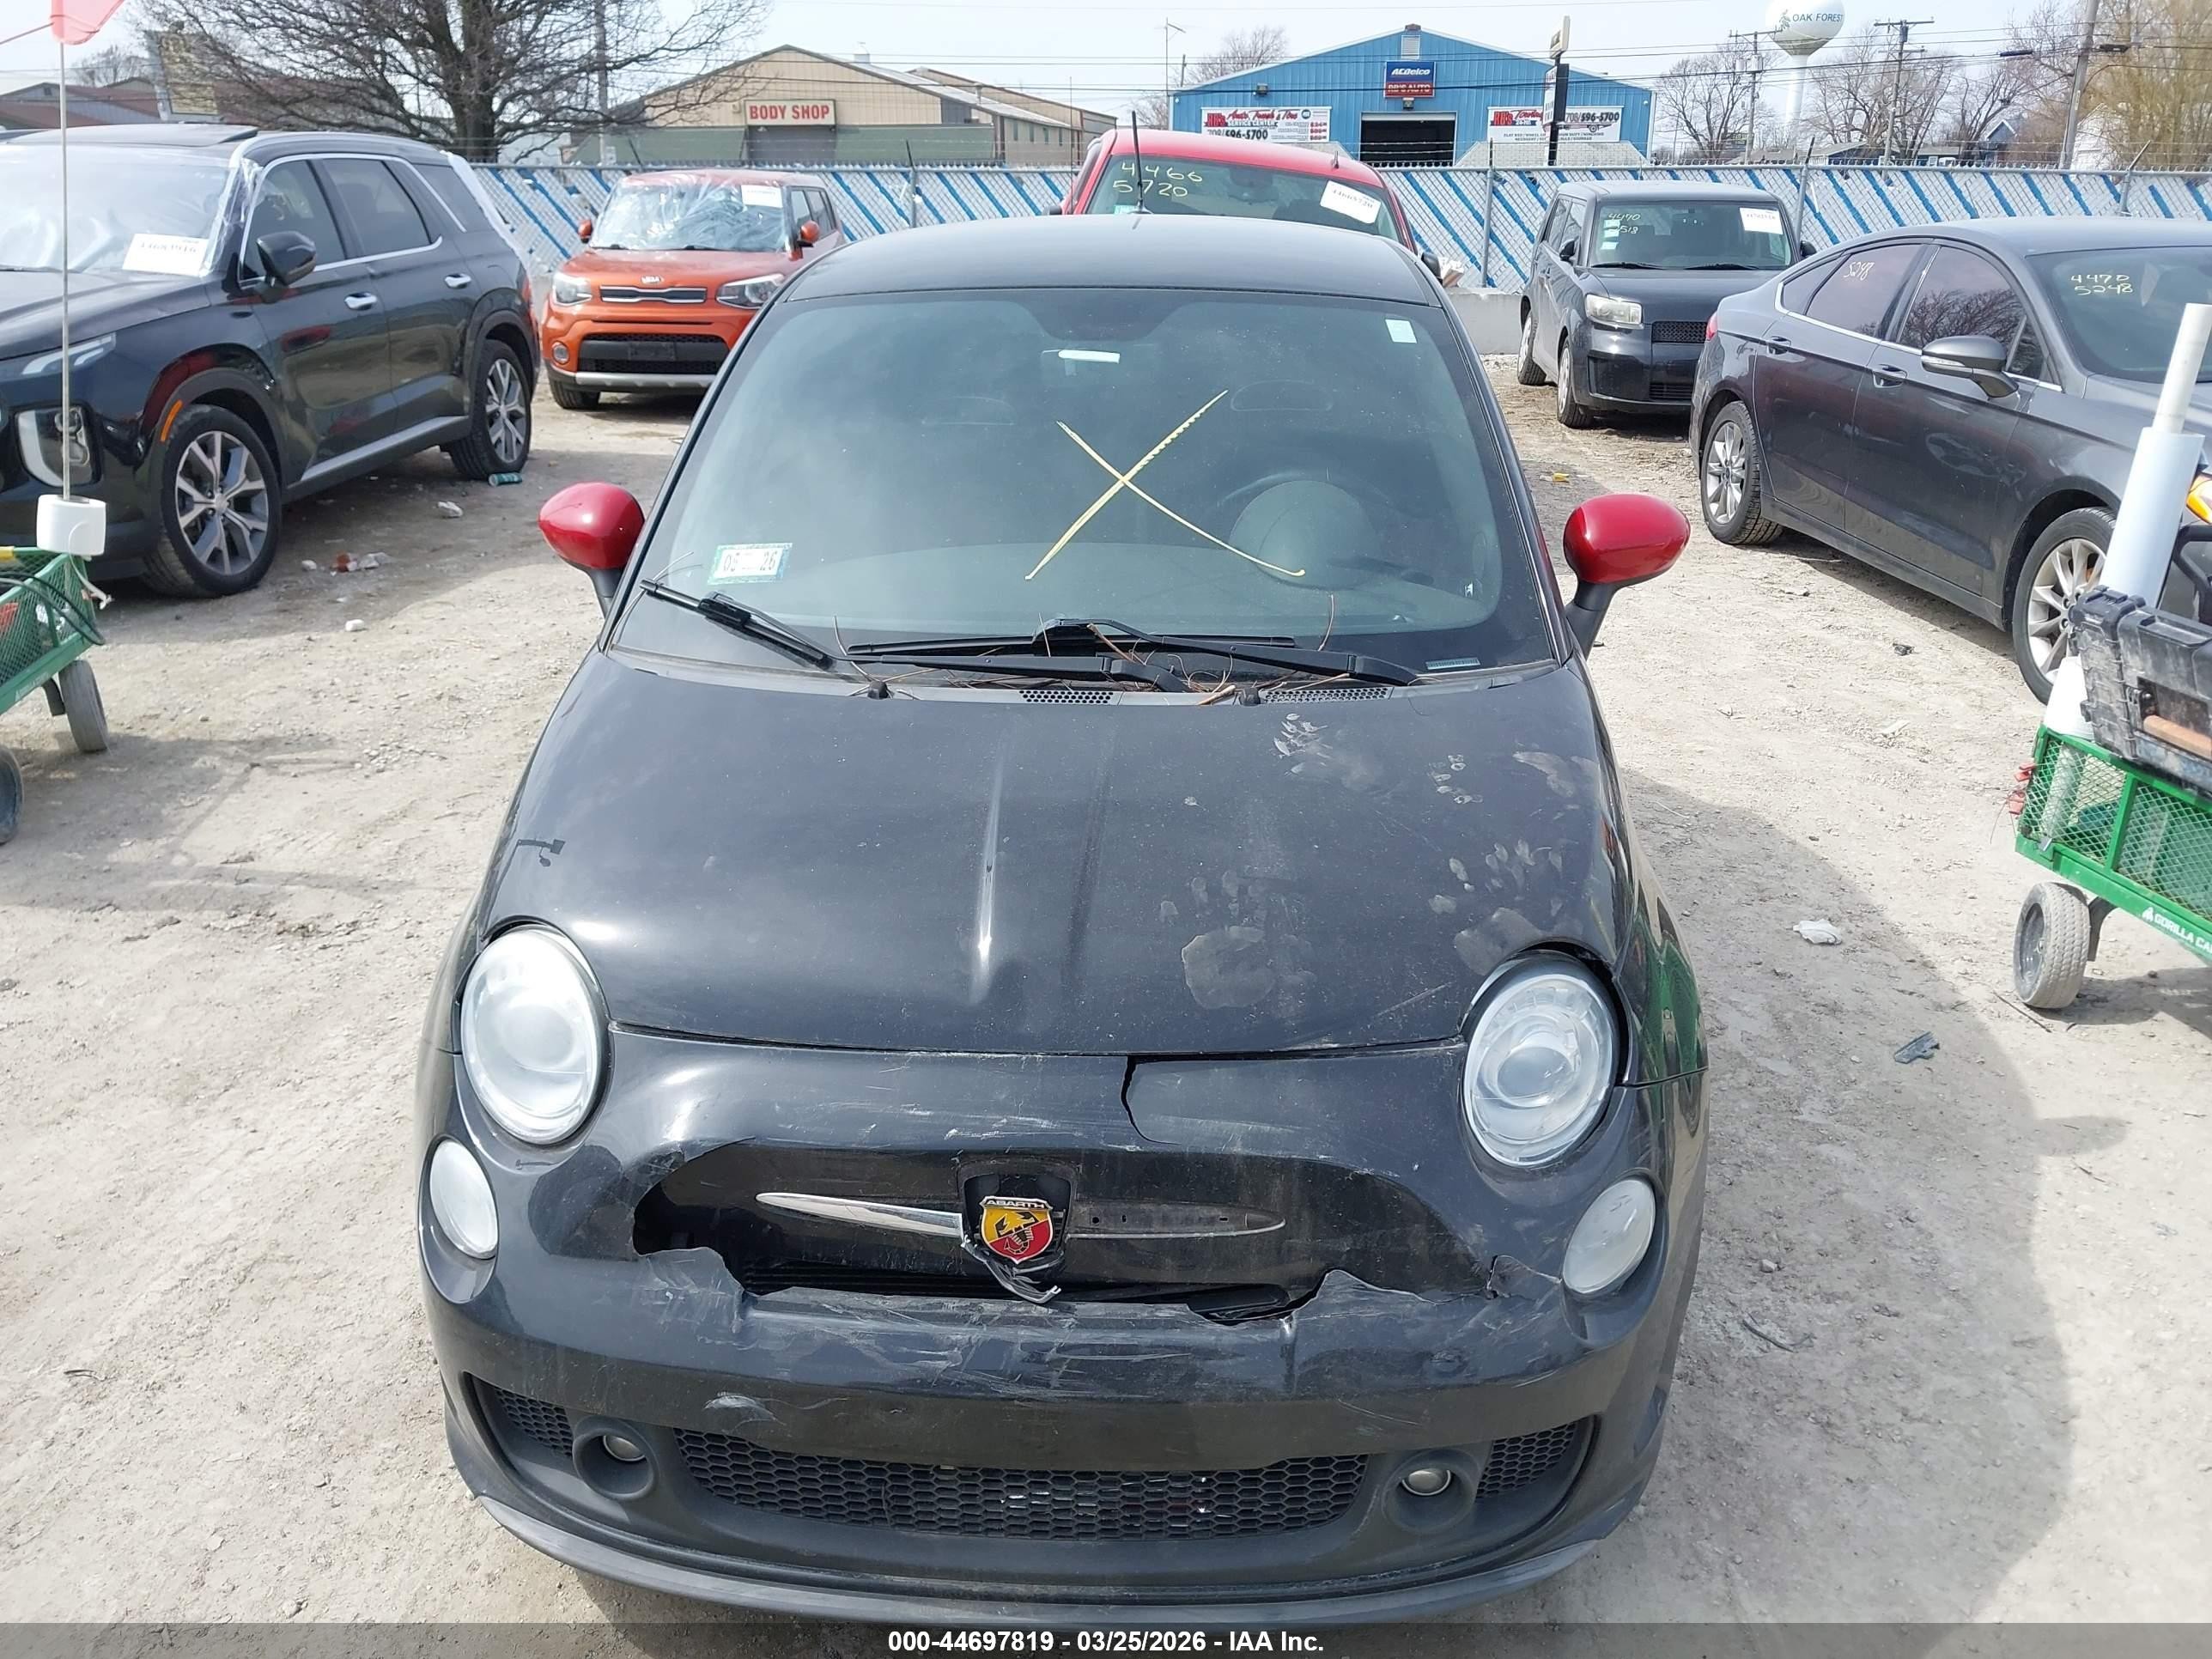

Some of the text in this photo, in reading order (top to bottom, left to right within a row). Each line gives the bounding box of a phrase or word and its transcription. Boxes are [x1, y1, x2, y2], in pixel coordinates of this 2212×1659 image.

[1792, 13, 1843, 21] OAK FOREST
[1407, 84, 1431, 93] AUTO
[749, 105, 830, 120] BODY SHOP
[1565, 112, 1620, 123] 708/596-5700
[1121, 161, 1203, 182] 4466
[1112, 179, 1188, 197] 5720
[2074, 283, 2134, 295] 5248
[2154, 914, 2212, 953] GORILLA CA
